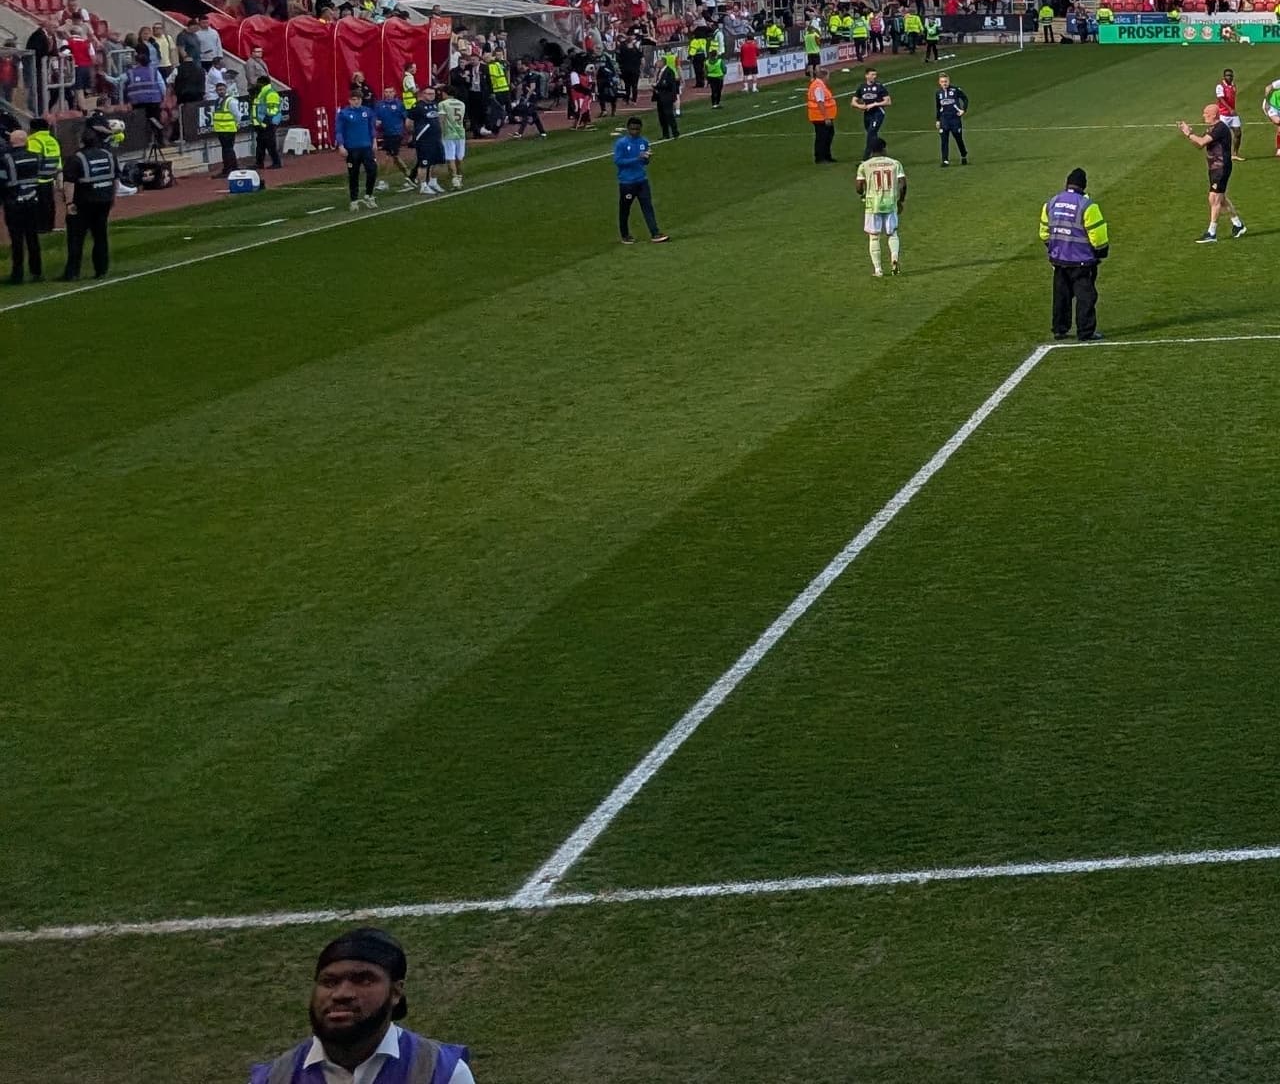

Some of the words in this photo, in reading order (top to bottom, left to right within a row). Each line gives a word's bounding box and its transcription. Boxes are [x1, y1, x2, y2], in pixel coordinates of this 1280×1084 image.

[1118, 26, 1180, 39] PROSPER
[454, 108, 462, 122] 5
[873, 170, 892, 192] 11
